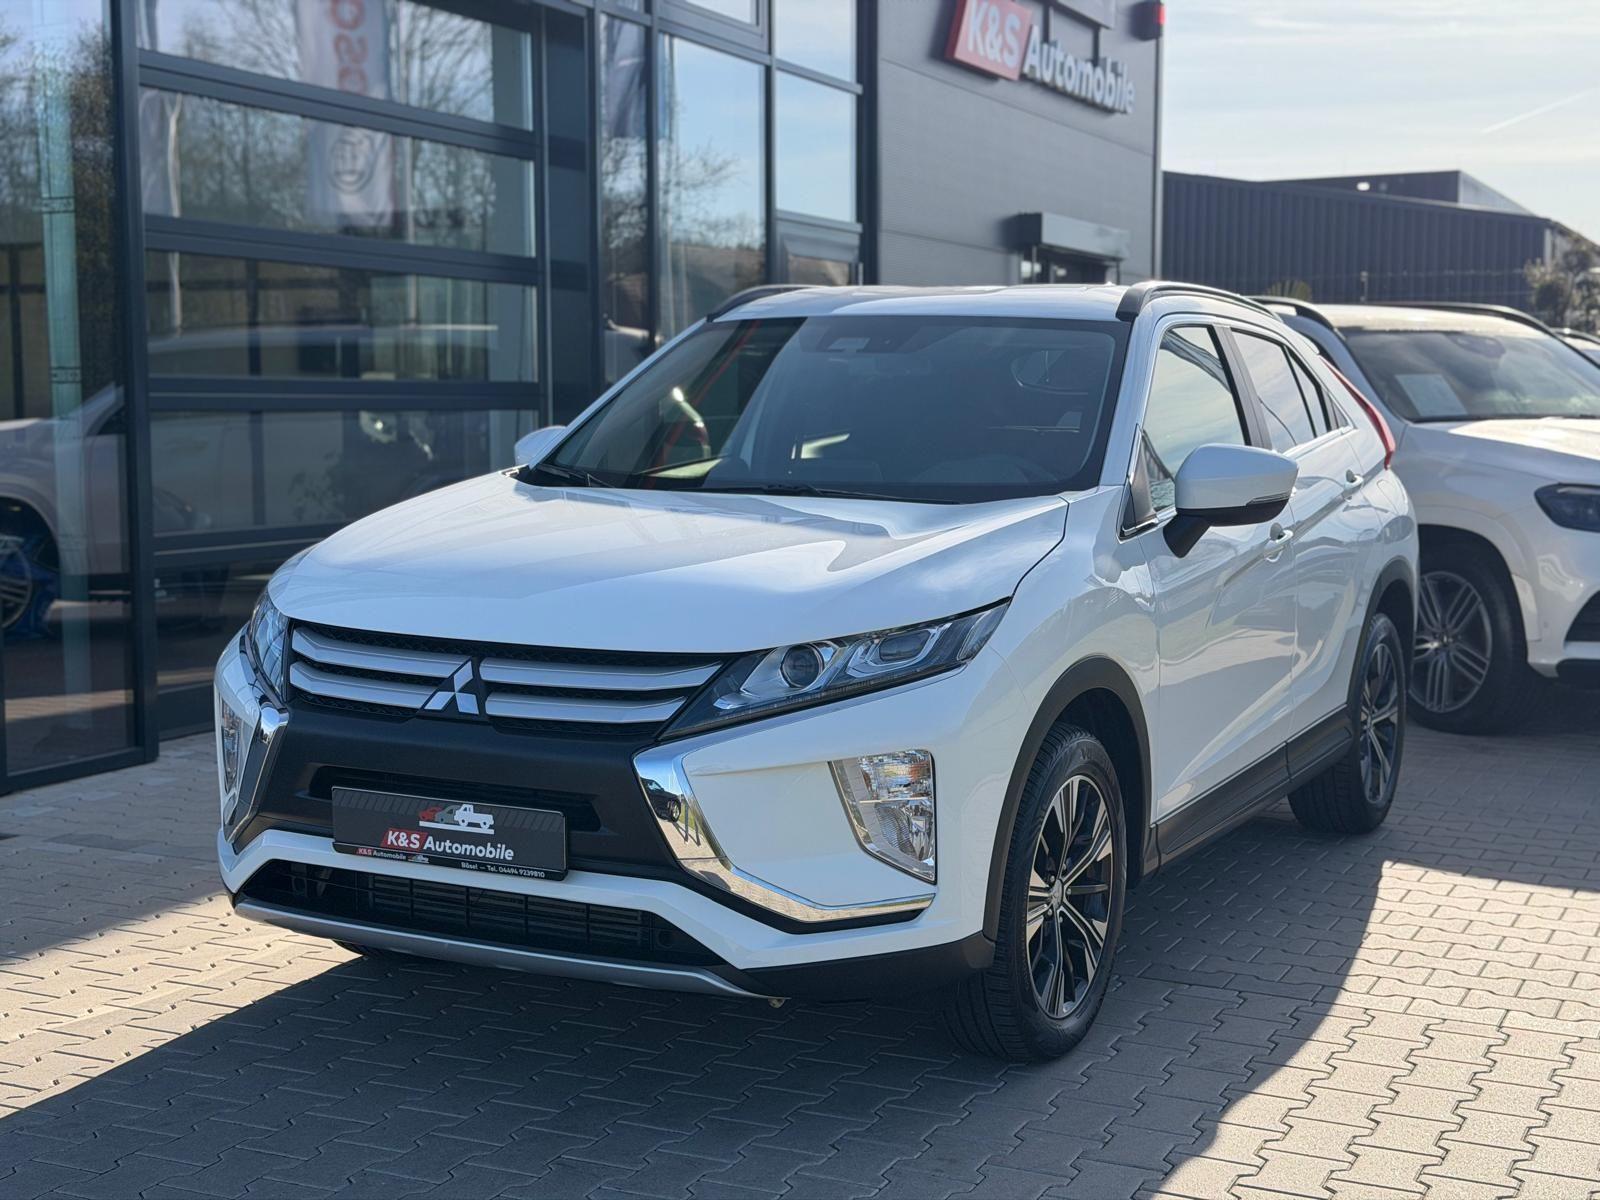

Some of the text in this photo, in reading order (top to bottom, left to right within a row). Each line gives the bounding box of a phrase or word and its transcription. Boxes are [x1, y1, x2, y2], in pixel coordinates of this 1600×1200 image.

[967, 0, 1136, 114] K&S Automobile
[358, 848, 407, 860] K&S Automobile
[387, 830, 514, 860] K&S Automobile
